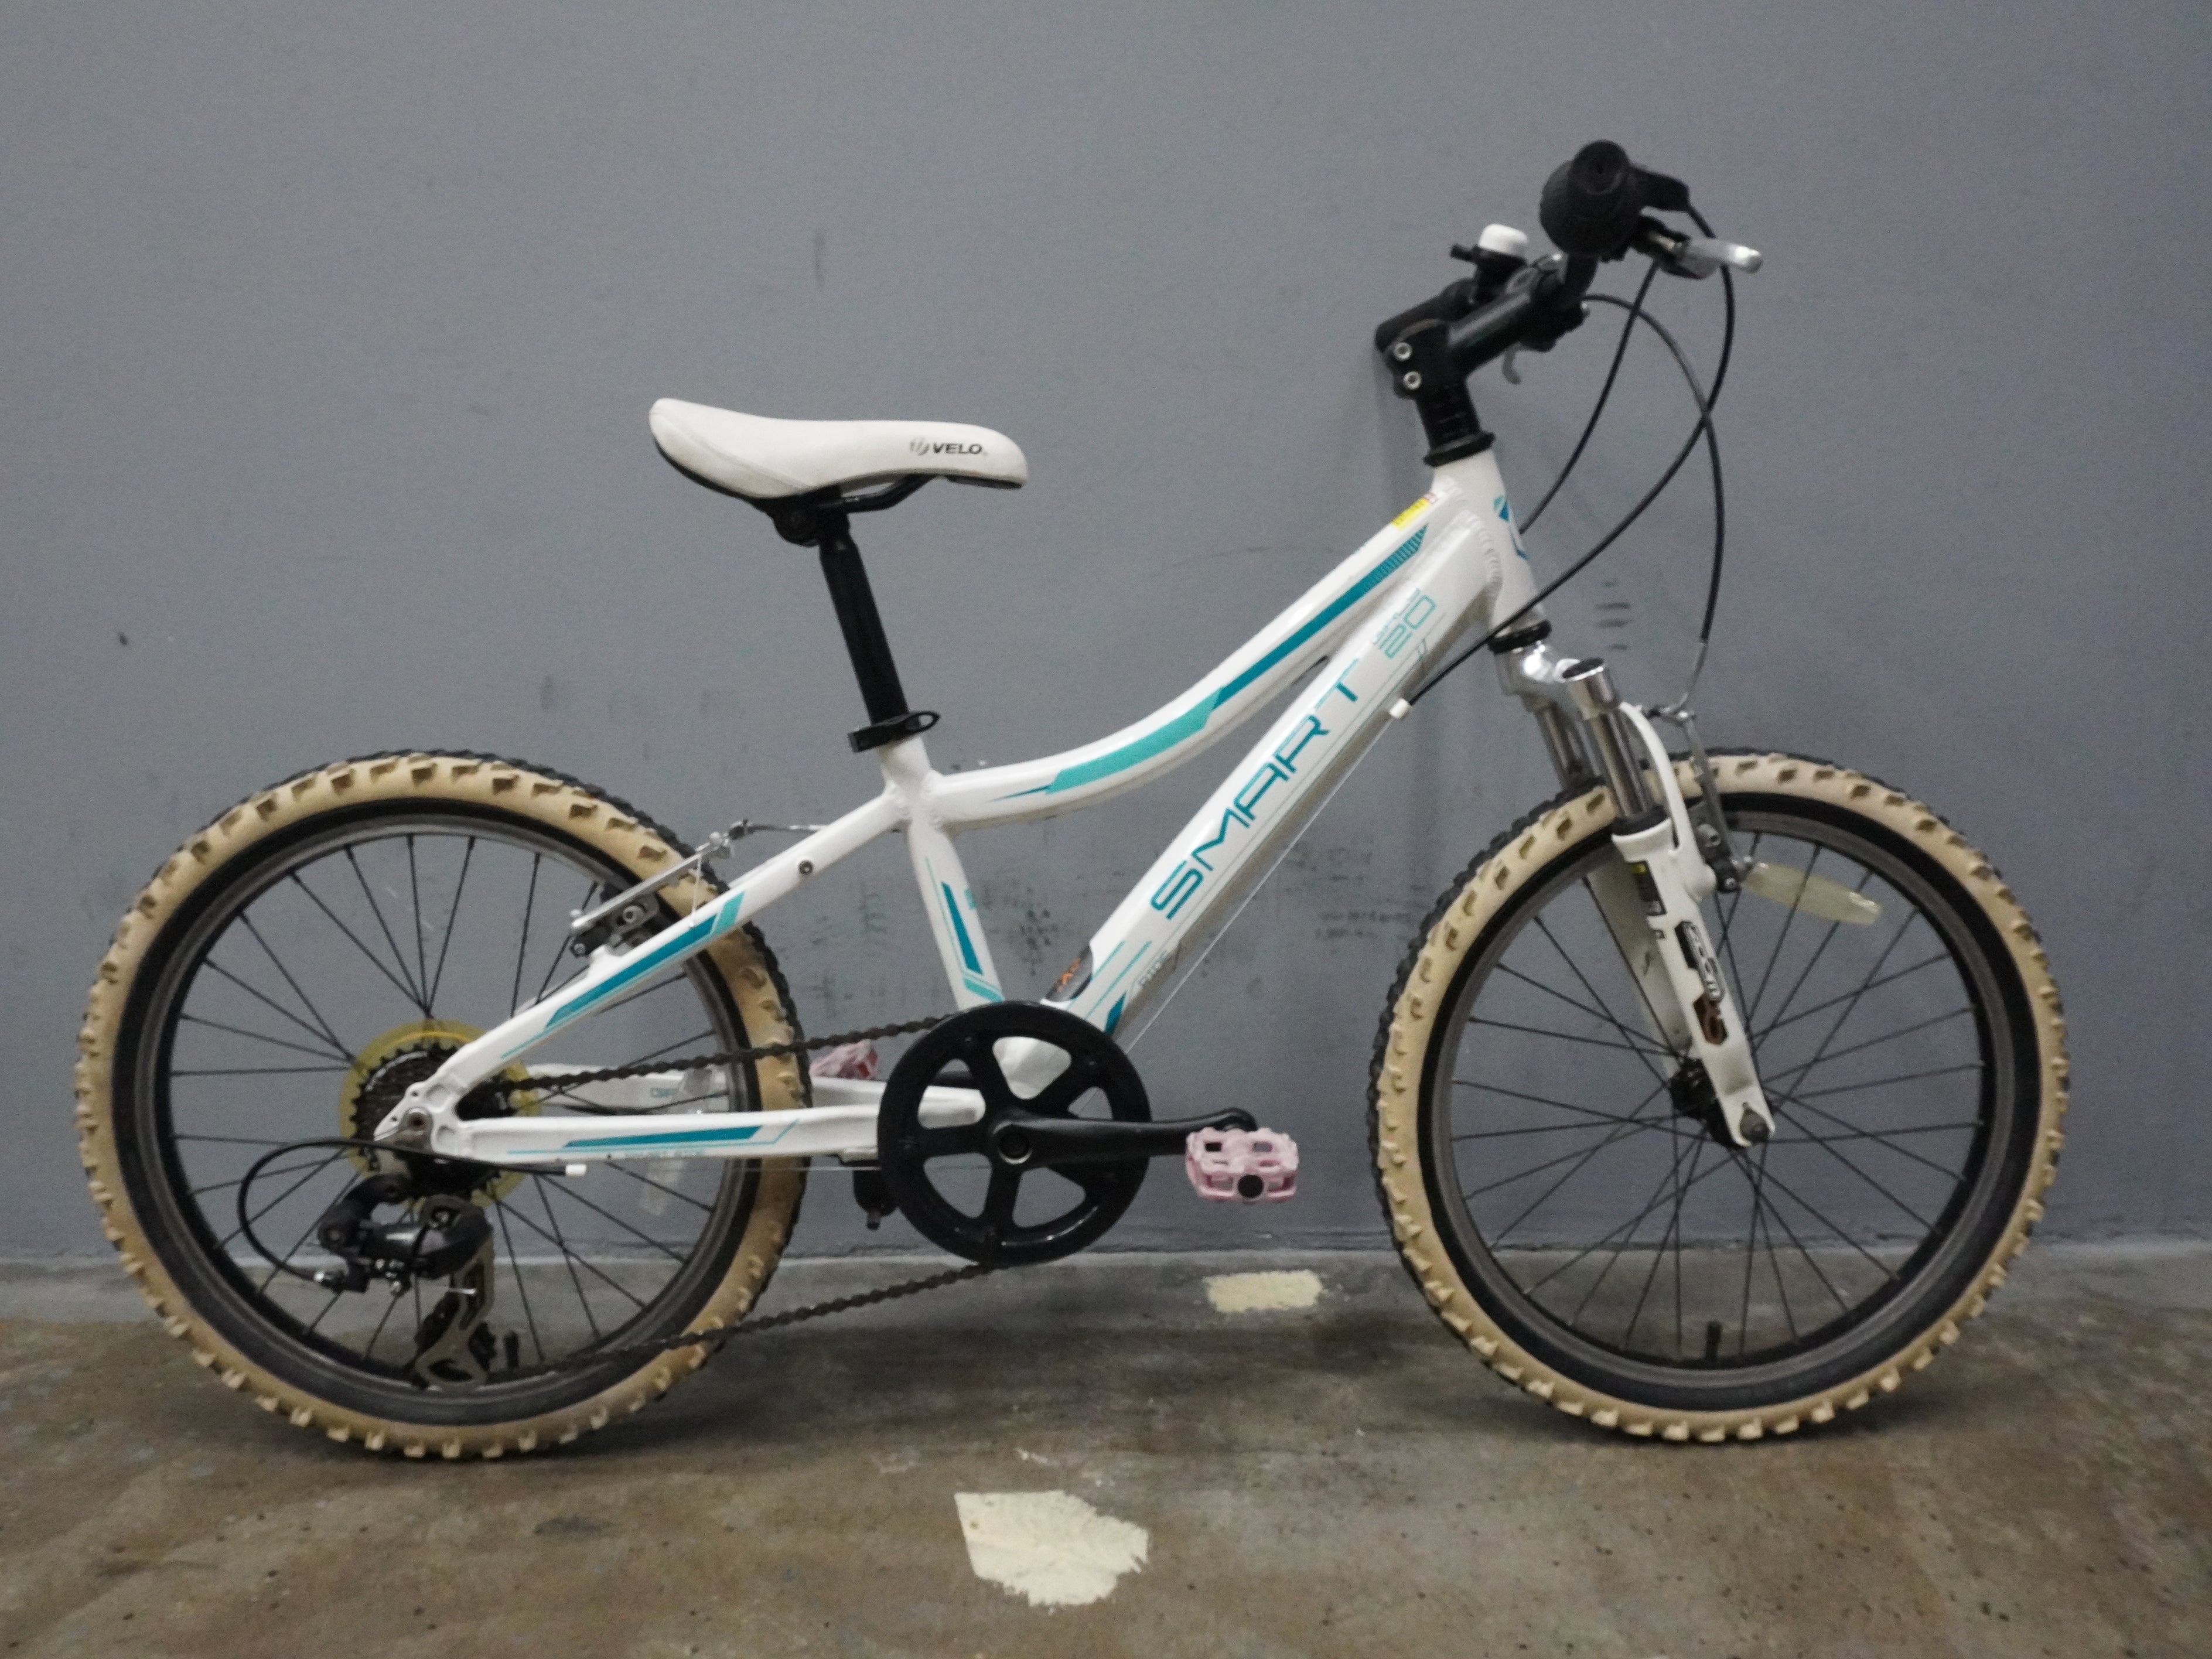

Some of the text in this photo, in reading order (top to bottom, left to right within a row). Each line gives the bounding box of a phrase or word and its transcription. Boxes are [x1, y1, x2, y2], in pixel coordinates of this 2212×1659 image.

[933, 442, 983, 455] VELO
[1149, 593, 1438, 920] SMART 20
